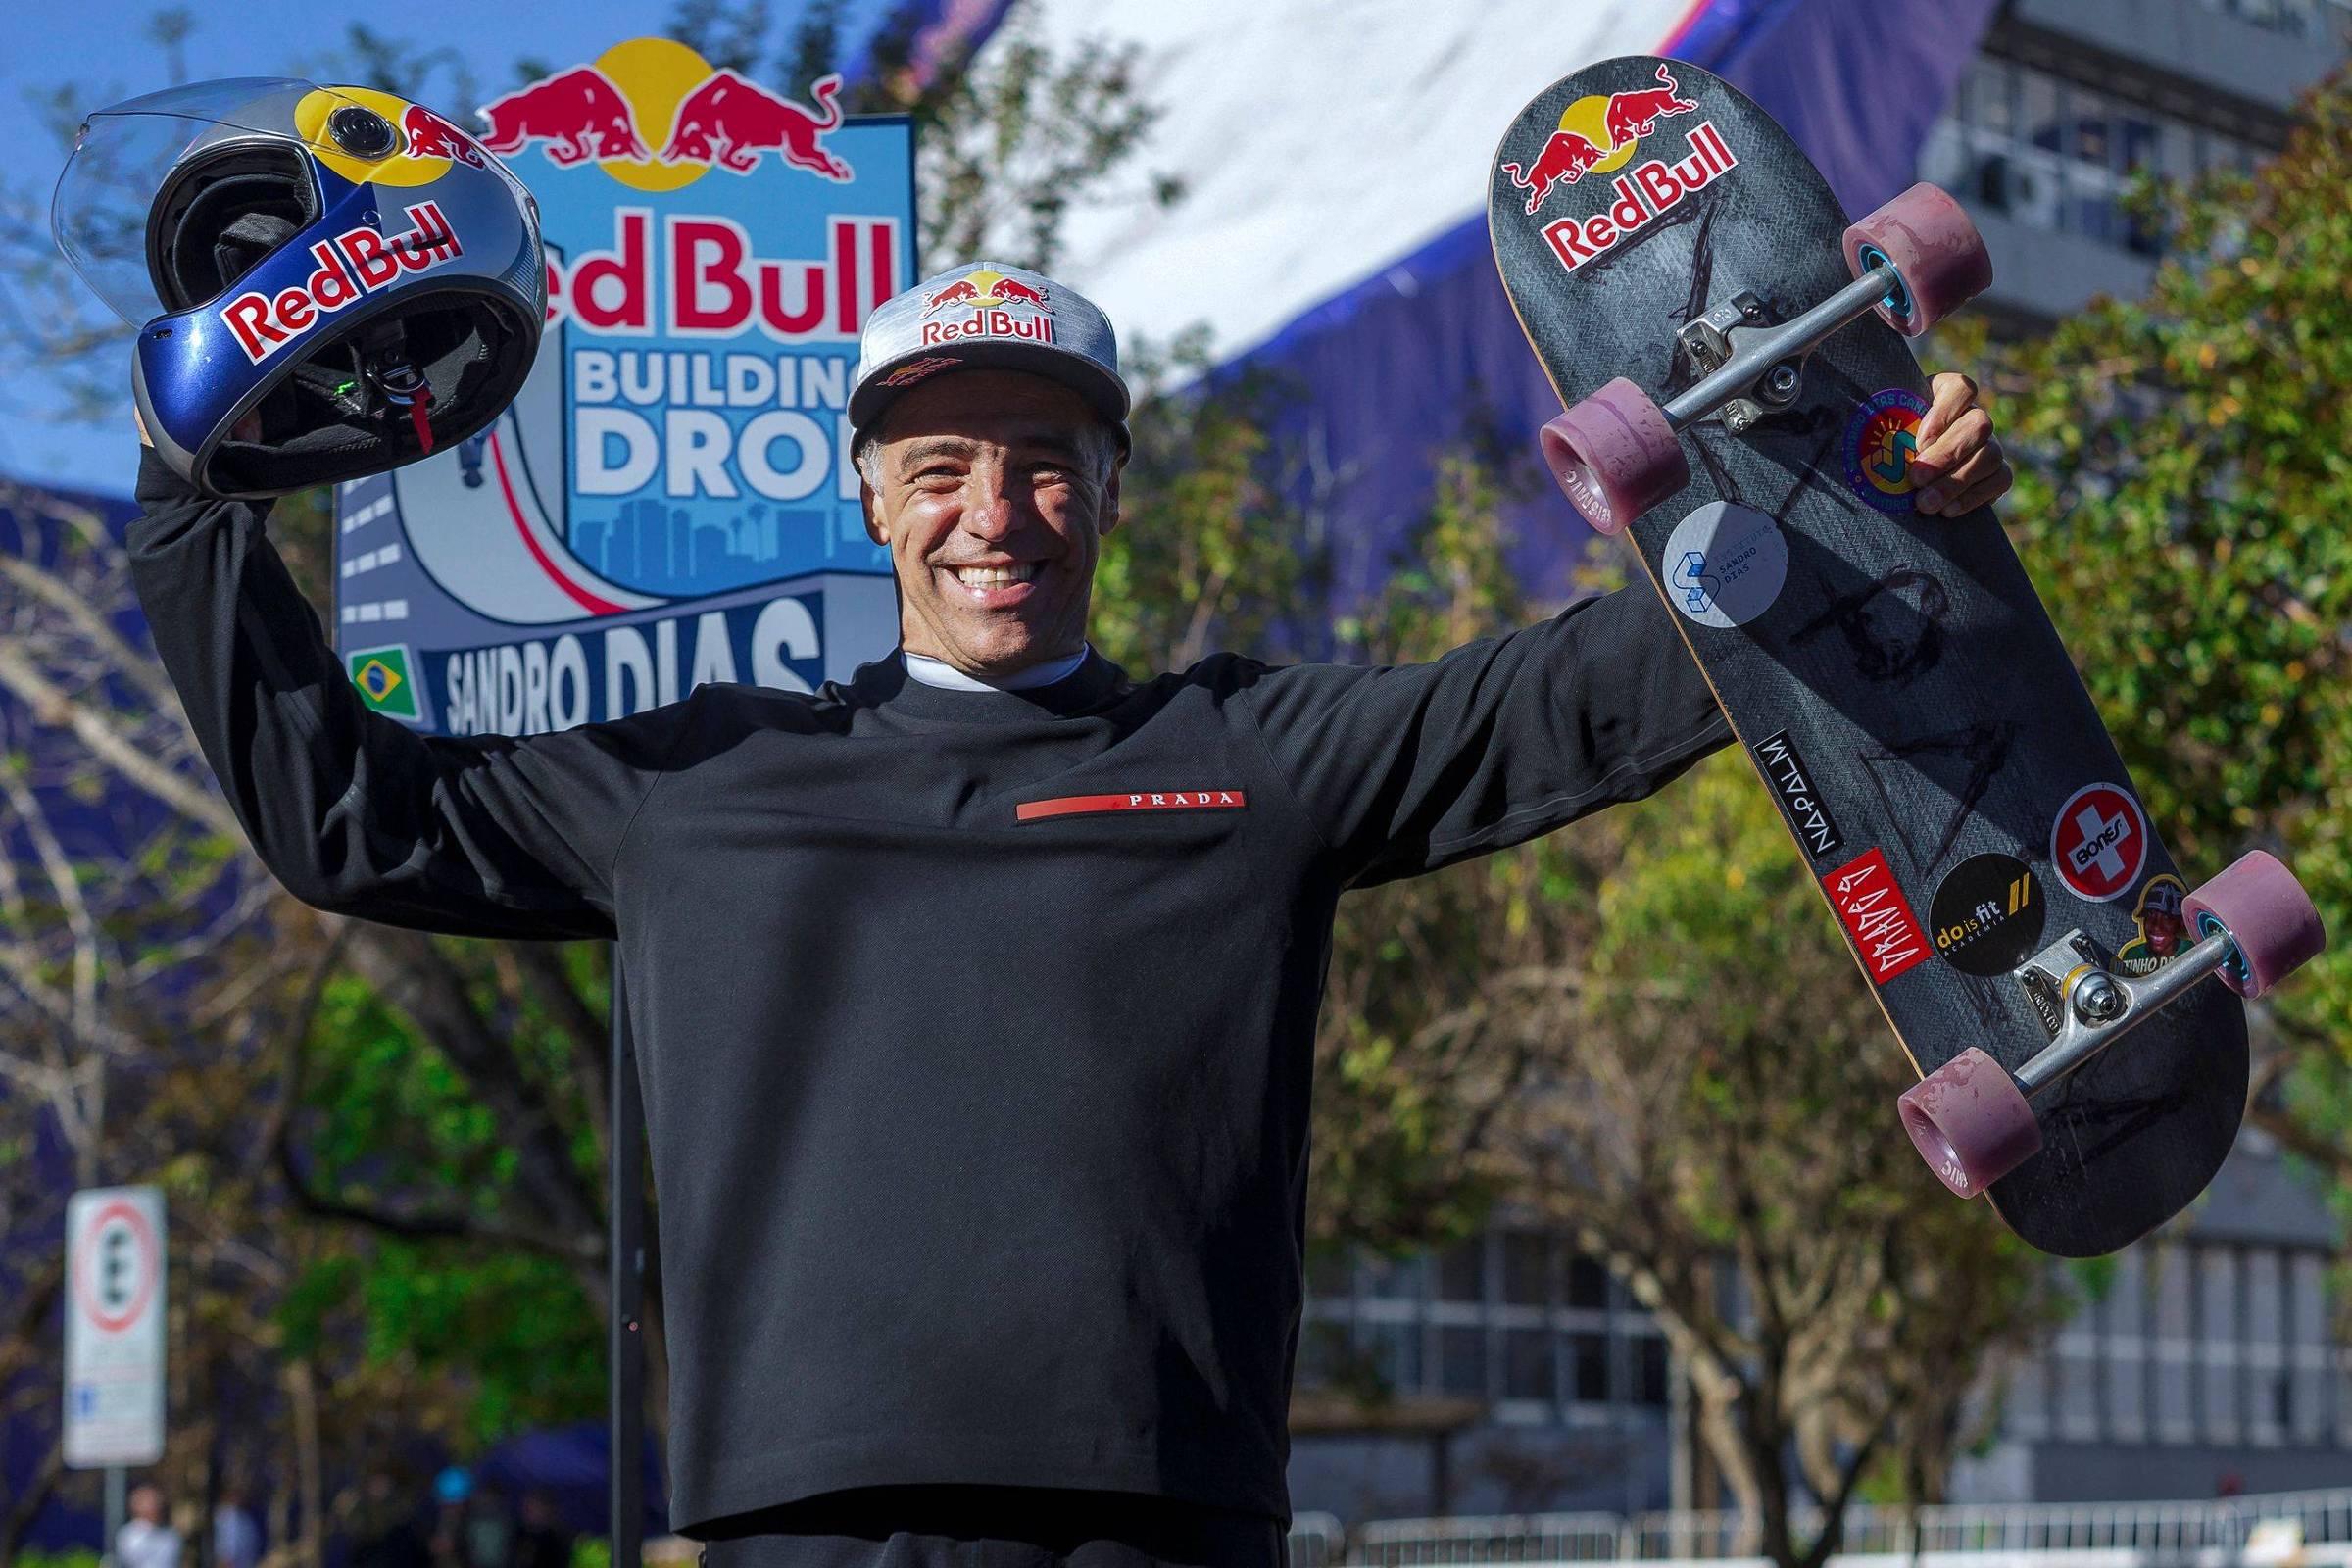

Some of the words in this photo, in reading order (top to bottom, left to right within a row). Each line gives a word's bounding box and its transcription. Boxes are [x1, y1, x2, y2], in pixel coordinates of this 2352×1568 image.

[1544, 177, 1650, 270] Red
[1635, 123, 1735, 211] Bull
[224, 243, 358, 361] Red
[341, 203, 463, 290] Bull
[674, 222, 891, 334] Bull
[923, 311, 983, 345] Red
[990, 311, 1053, 343] Bull
[574, 351, 859, 409] BUILDIN
[1719, 546, 1757, 574] SANDRO
[1724, 564, 1750, 584] DIAS
[447, 633, 590, 736] SANDRO
[605, 597, 820, 720] DIAS
[1130, 793, 1233, 806] PRADA
[1761, 739, 1835, 853] NAPALM
[2076, 819, 2123, 866] BONES
[1944, 915, 2005, 956] ACADEMIA
